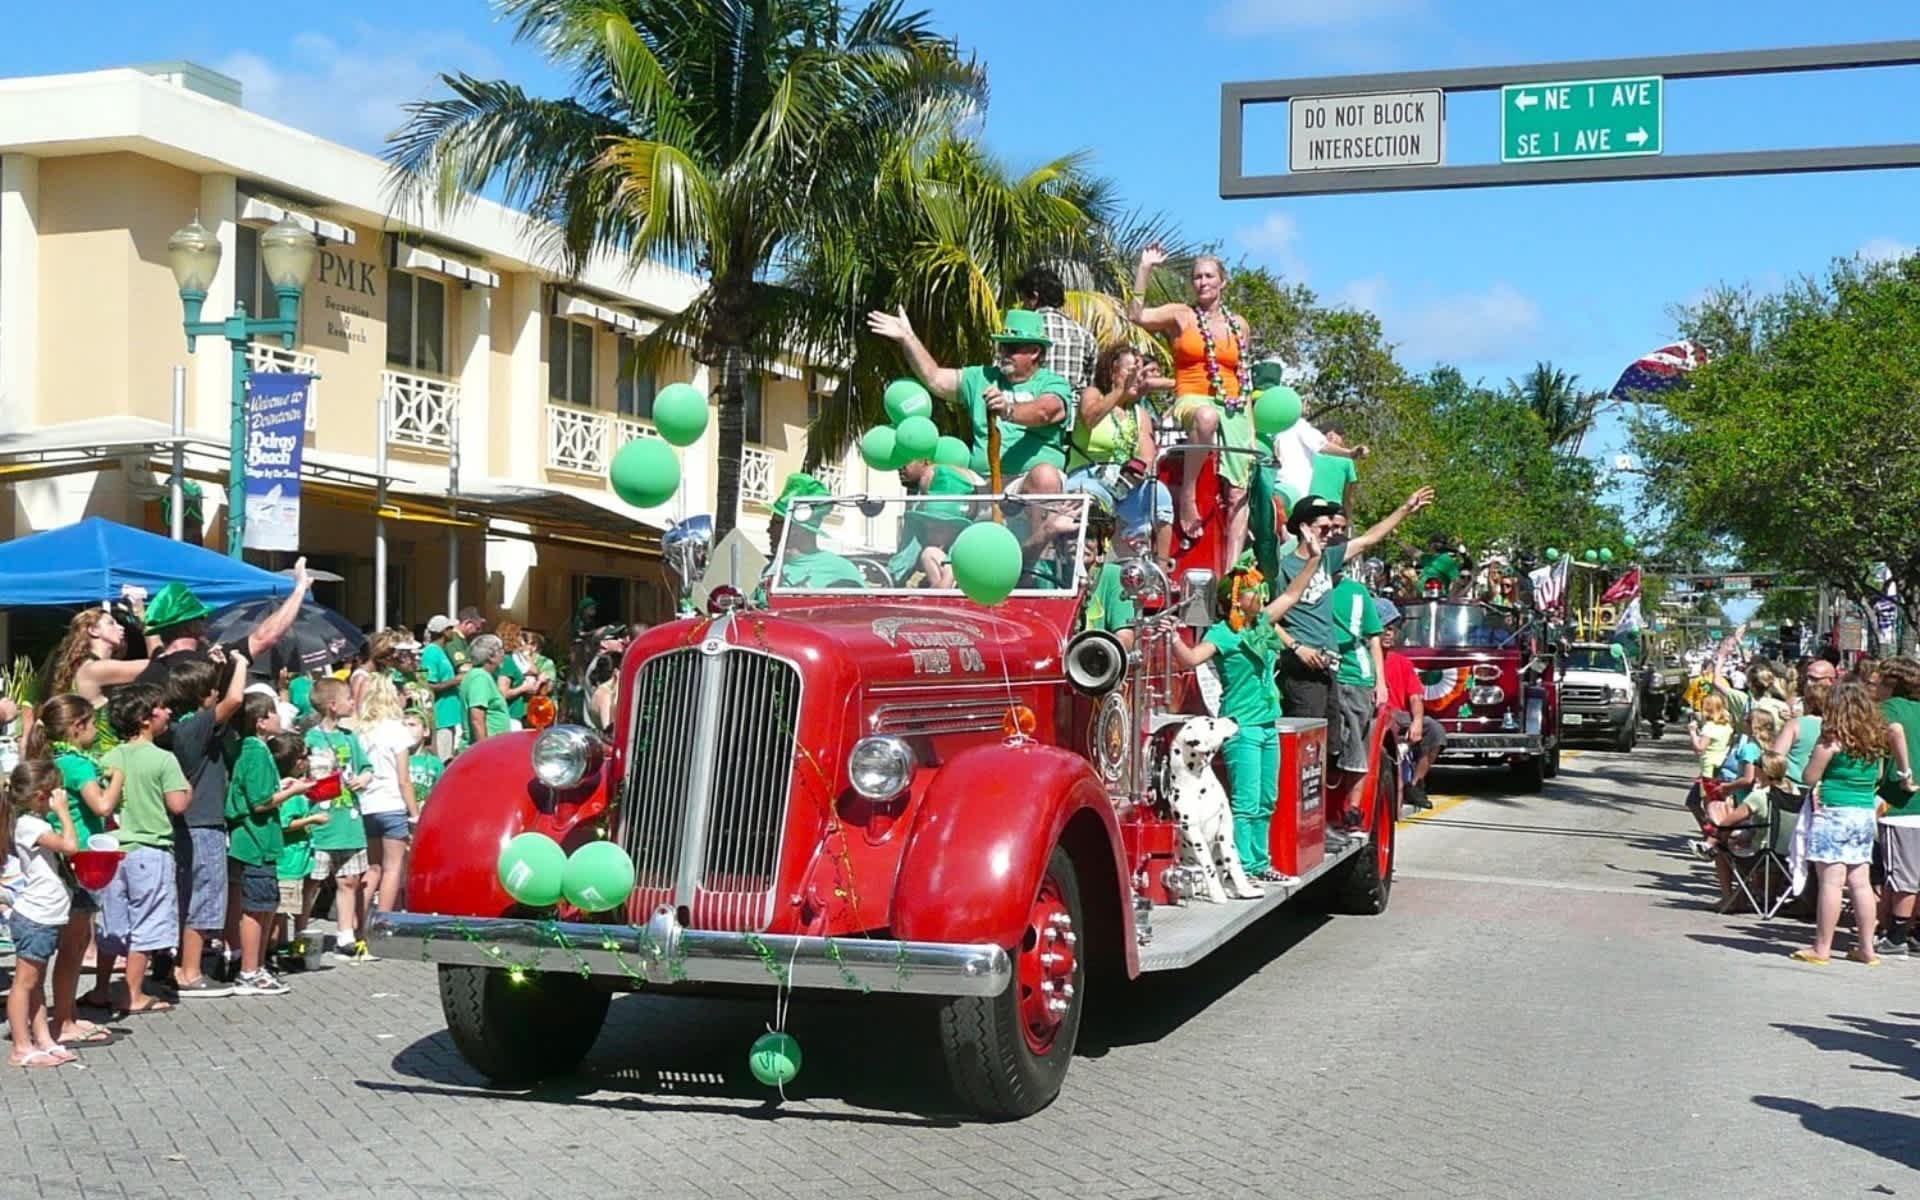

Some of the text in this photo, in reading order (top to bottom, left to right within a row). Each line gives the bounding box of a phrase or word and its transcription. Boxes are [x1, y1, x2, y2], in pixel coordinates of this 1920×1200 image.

[1545, 88, 1570, 111] NE
[1611, 83, 1652, 106] AVE
[1304, 102, 1425, 129] DO NOT BLOCK
[1309, 135, 1421, 161] INTERSECTION
[1517, 133, 1541, 155] SE
[1575, 129, 1611, 151] AVE
[318, 249, 377, 297] PMK
[250, 431, 297, 452] Delray
[248, 447, 292, 467] Beach
